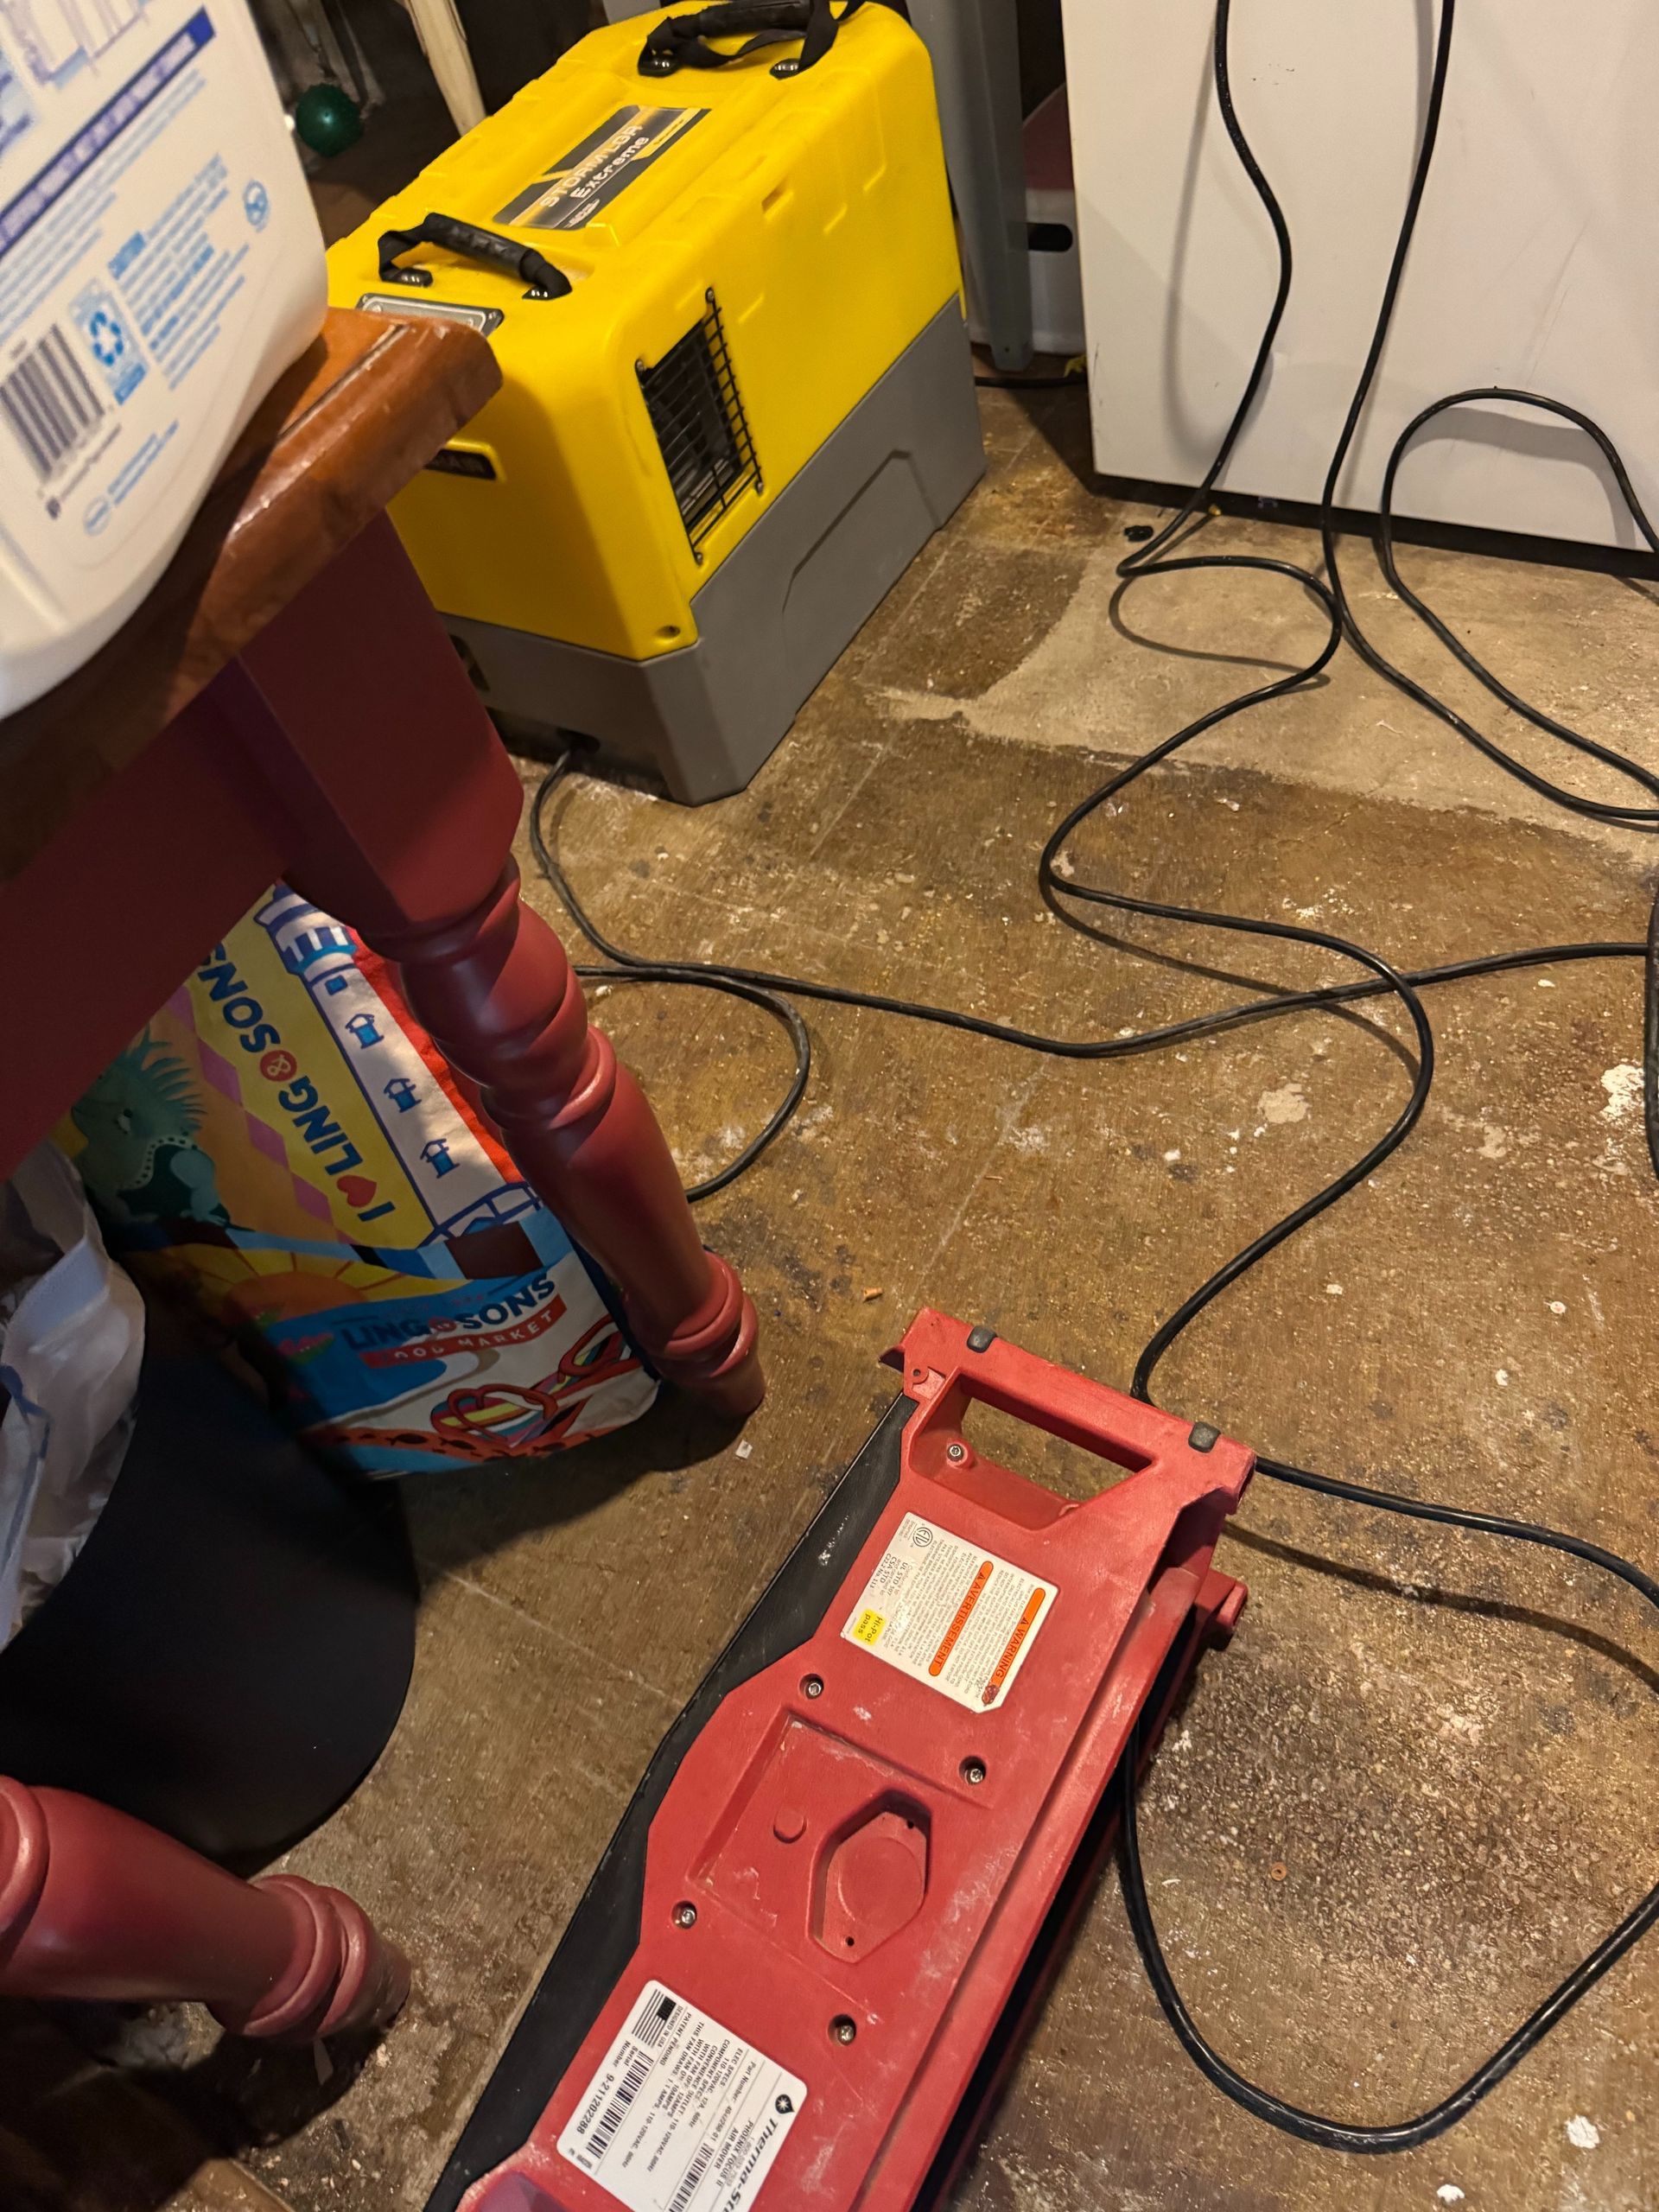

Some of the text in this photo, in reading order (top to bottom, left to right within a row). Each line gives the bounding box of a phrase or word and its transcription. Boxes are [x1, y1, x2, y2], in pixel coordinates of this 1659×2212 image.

[539, 149, 611, 208] STORM
[610, 124, 644, 153] LGR
[569, 137, 650, 200] Extreme
[278, 1077, 364, 1177] LING
[357, 1200, 396, 1222] I
[340, 1319, 431, 1350] LING
[455, 1274, 555, 1331] SONS
[458, 1308, 553, 1349] MARKET
[868, 1552, 891, 1588] C22.2 No. 113
[879, 1555, 897, 1583] CSA STD
[886, 1561, 907, 1596] UL STD 507
[855, 1613, 871, 1634] pass
[864, 1615, 882, 1643] Hi-Pot
[933, 1581, 982, 1667] AVERTISSEMENT
[994, 1627, 1025, 1678] WARNING
[665, 2005, 683, 2031] DESIGNED
[692, 2020, 704, 2037] THIS
[656, 2036, 665, 2048] USA
[658, 2012, 691, 2066] PATENT PENDING
[684, 2036, 696, 2051] FAN
[690, 2037, 703, 2056] WITH
[696, 2043, 710, 2061] WITH
[612, 2040, 631, 2068] Number
[623, 2045, 638, 2066] Serial
[683, 2056, 694, 2070] FAN
[689, 2060, 701, 2075] FAN
[690, 2044, 718, 2089] CONVENIENCE
[705, 2038, 730, 2079] COMPONENT
[730, 2047, 743, 2064] ELEC
[745, 2061, 756, 2075] Part
[575, 2072, 614, 2134] 9-211202288
[661, 2083, 679, 2110] 10AMPS
[666, 2090, 683, 2117] 12AMPS
[713, 2126, 739, 2169] AIR MOVER
[733, 2120, 753, 2152] PHOENIX
[719, 2152, 736, 2178] FOCUS
[721, 2116, 779, 2212] Therma-St
